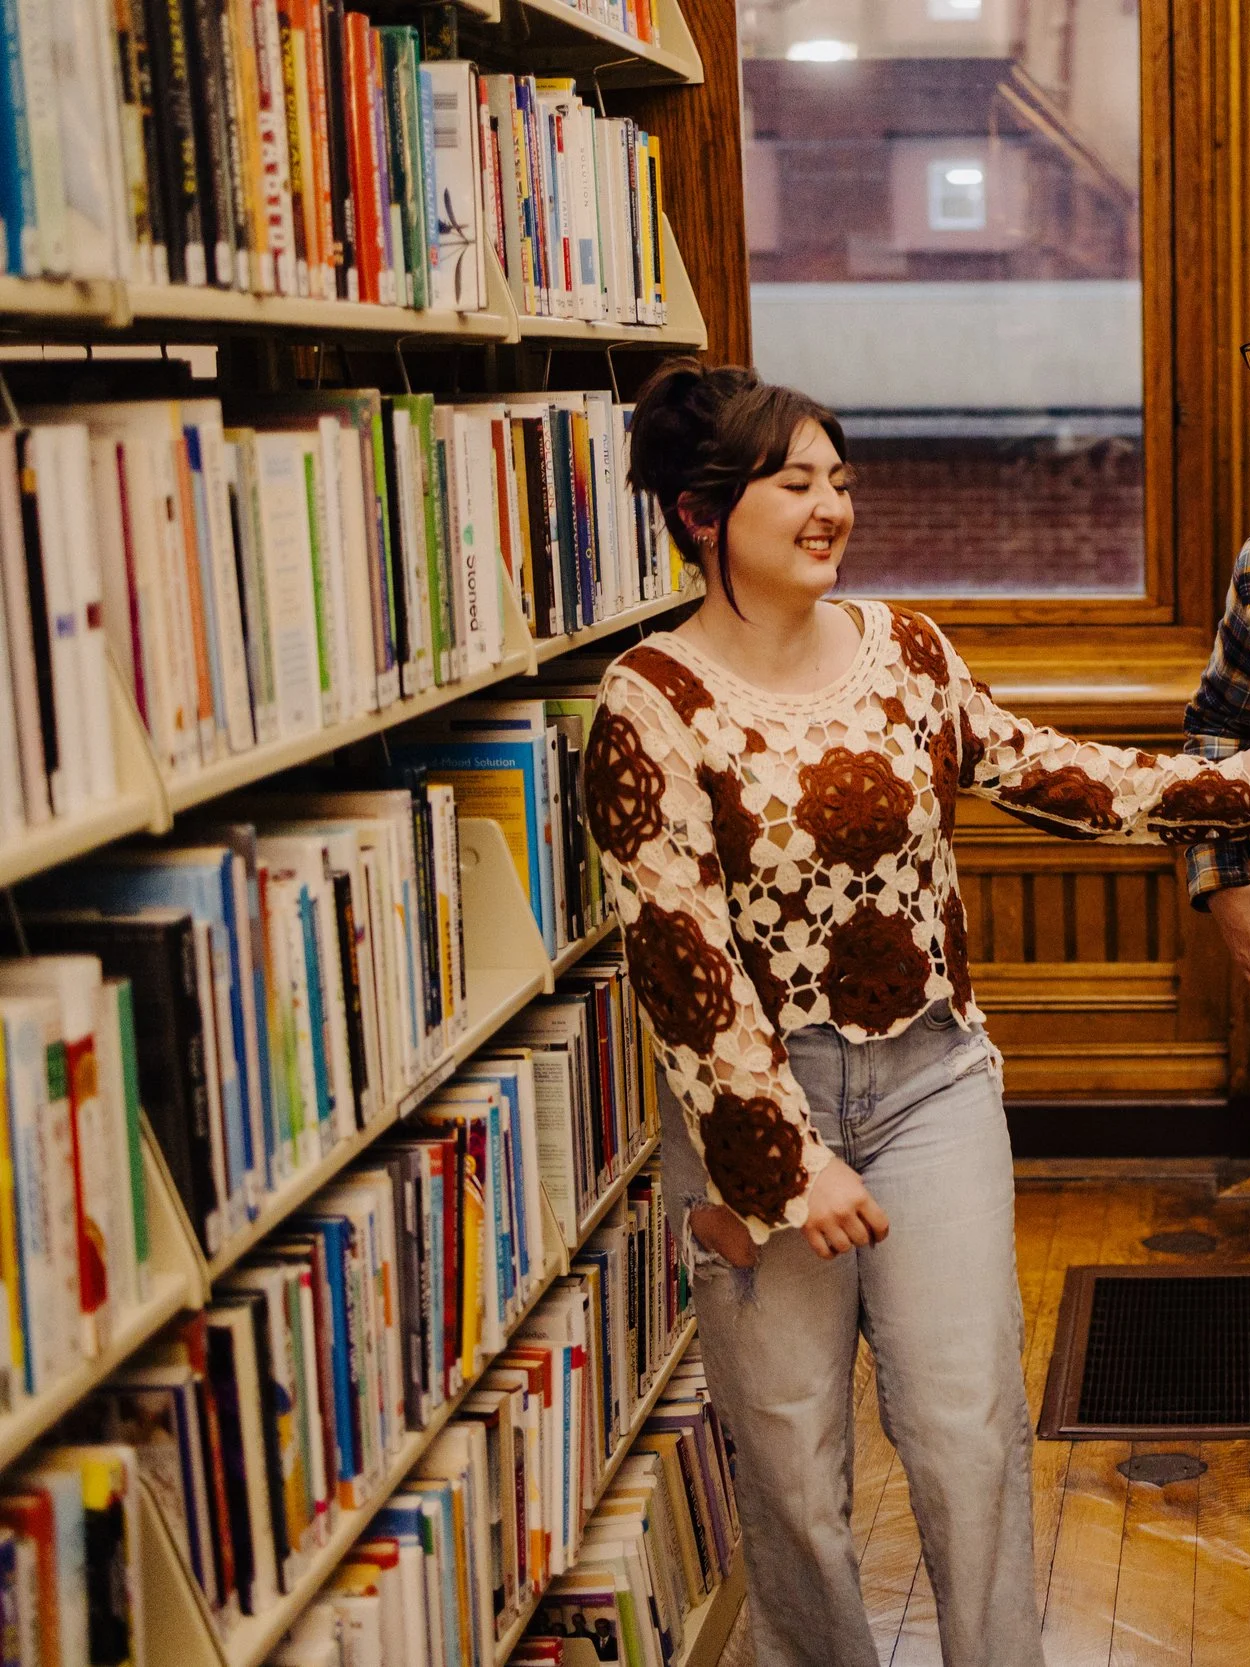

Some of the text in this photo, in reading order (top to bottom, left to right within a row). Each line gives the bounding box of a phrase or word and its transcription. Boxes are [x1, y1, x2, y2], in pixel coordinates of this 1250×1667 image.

[287, 94, 304, 195] DISEASE
[423, 118, 436, 241] DRUG GUIDE
[580, 147, 589, 209] SOLUTION
[543, 408, 555, 509] REVOLUTION
[568, 448, 582, 606] AUTISM ADULTHOOD
[466, 555, 482, 633] Stoned
[474, 757, 516, 767] Solution
[493, 1135, 502, 1217] PREVENTING
[689, 1482, 701, 1528] BEYOND
[702, 1551, 710, 1573] PILL
